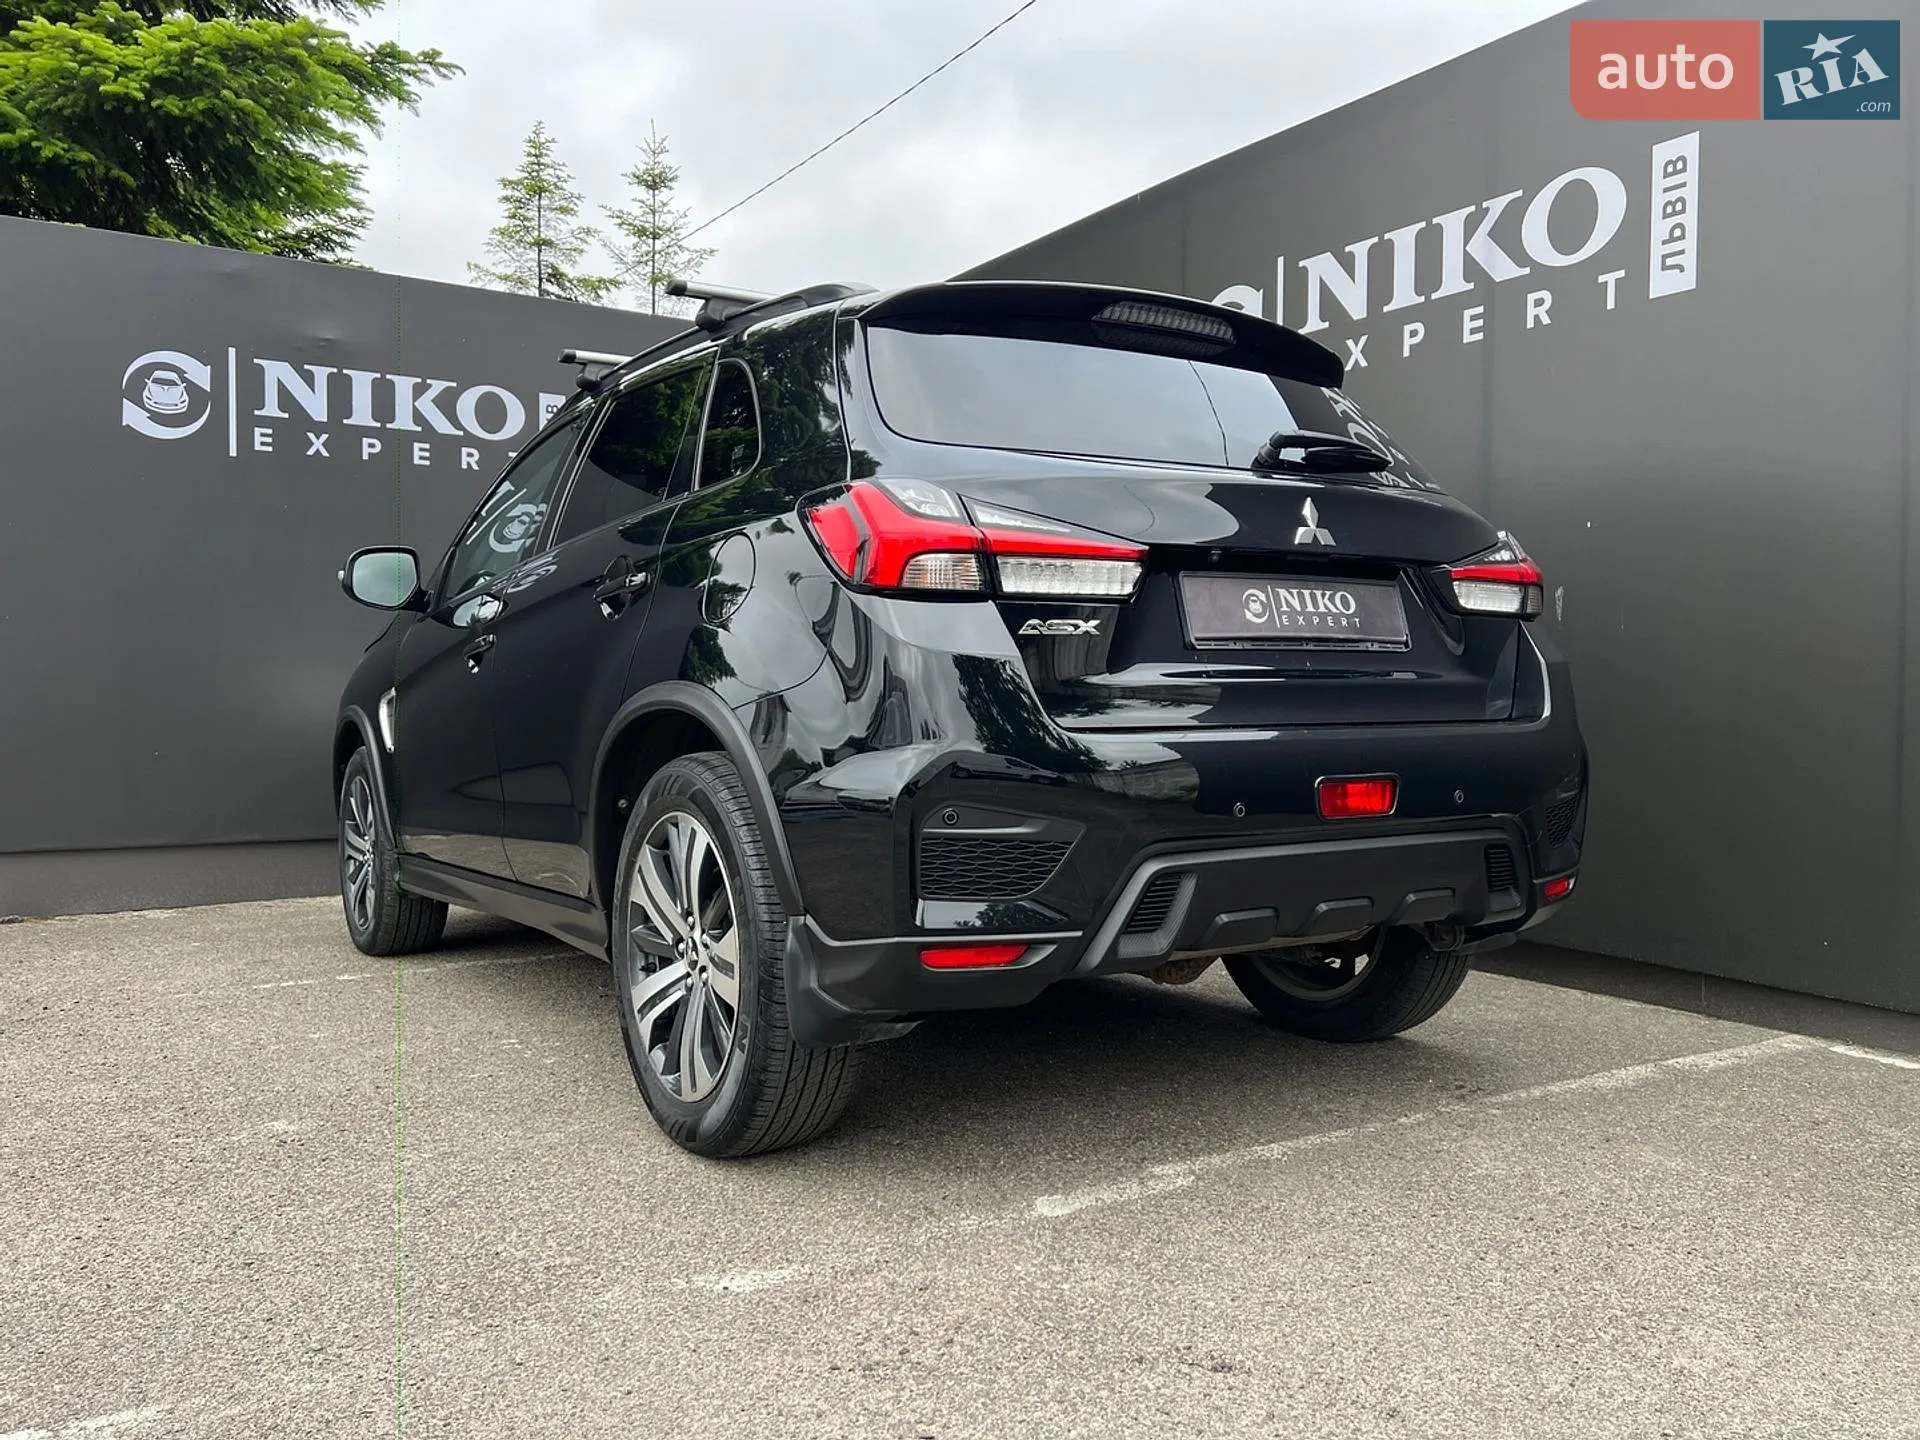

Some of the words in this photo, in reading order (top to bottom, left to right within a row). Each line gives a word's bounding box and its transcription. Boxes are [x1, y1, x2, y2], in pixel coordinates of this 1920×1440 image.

[1298, 166, 1627, 334] NIKO
[1344, 269, 1626, 370] XPERT
[253, 358, 526, 440] NIKO
[1018, 619, 1100, 635] ASX
[1275, 588, 1356, 615] NIKO
[1283, 615, 1360, 628] EXPERT
